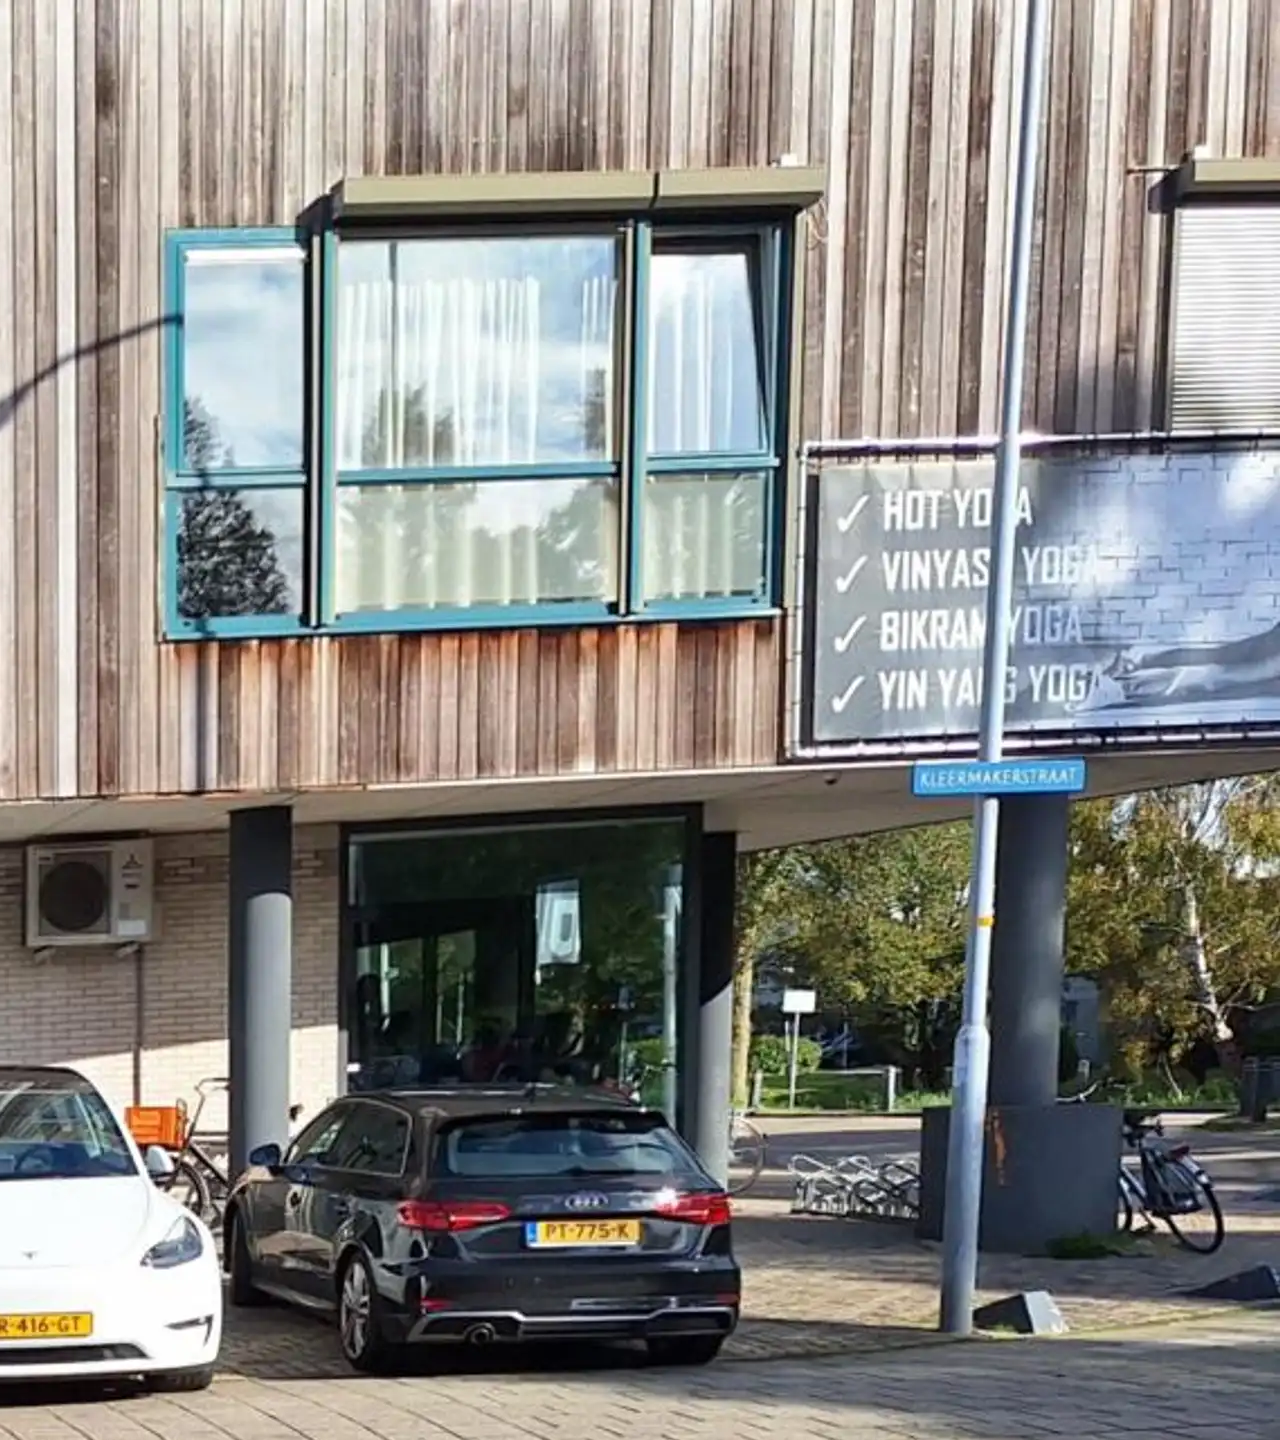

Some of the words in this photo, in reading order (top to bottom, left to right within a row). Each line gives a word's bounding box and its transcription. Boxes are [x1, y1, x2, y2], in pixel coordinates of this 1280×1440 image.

[883, 489, 944, 531] HOT
[953, 486, 1033, 529] YOA
[882, 547, 991, 592] VINYAS
[1021, 545, 1100, 586] YOGA
[877, 669, 928, 711] YIN
[938, 666, 1018, 707] YAG
[920, 767, 1077, 788] KLEERMAKERSTRAAT
[545, 1223, 629, 1239] PT-775-K
